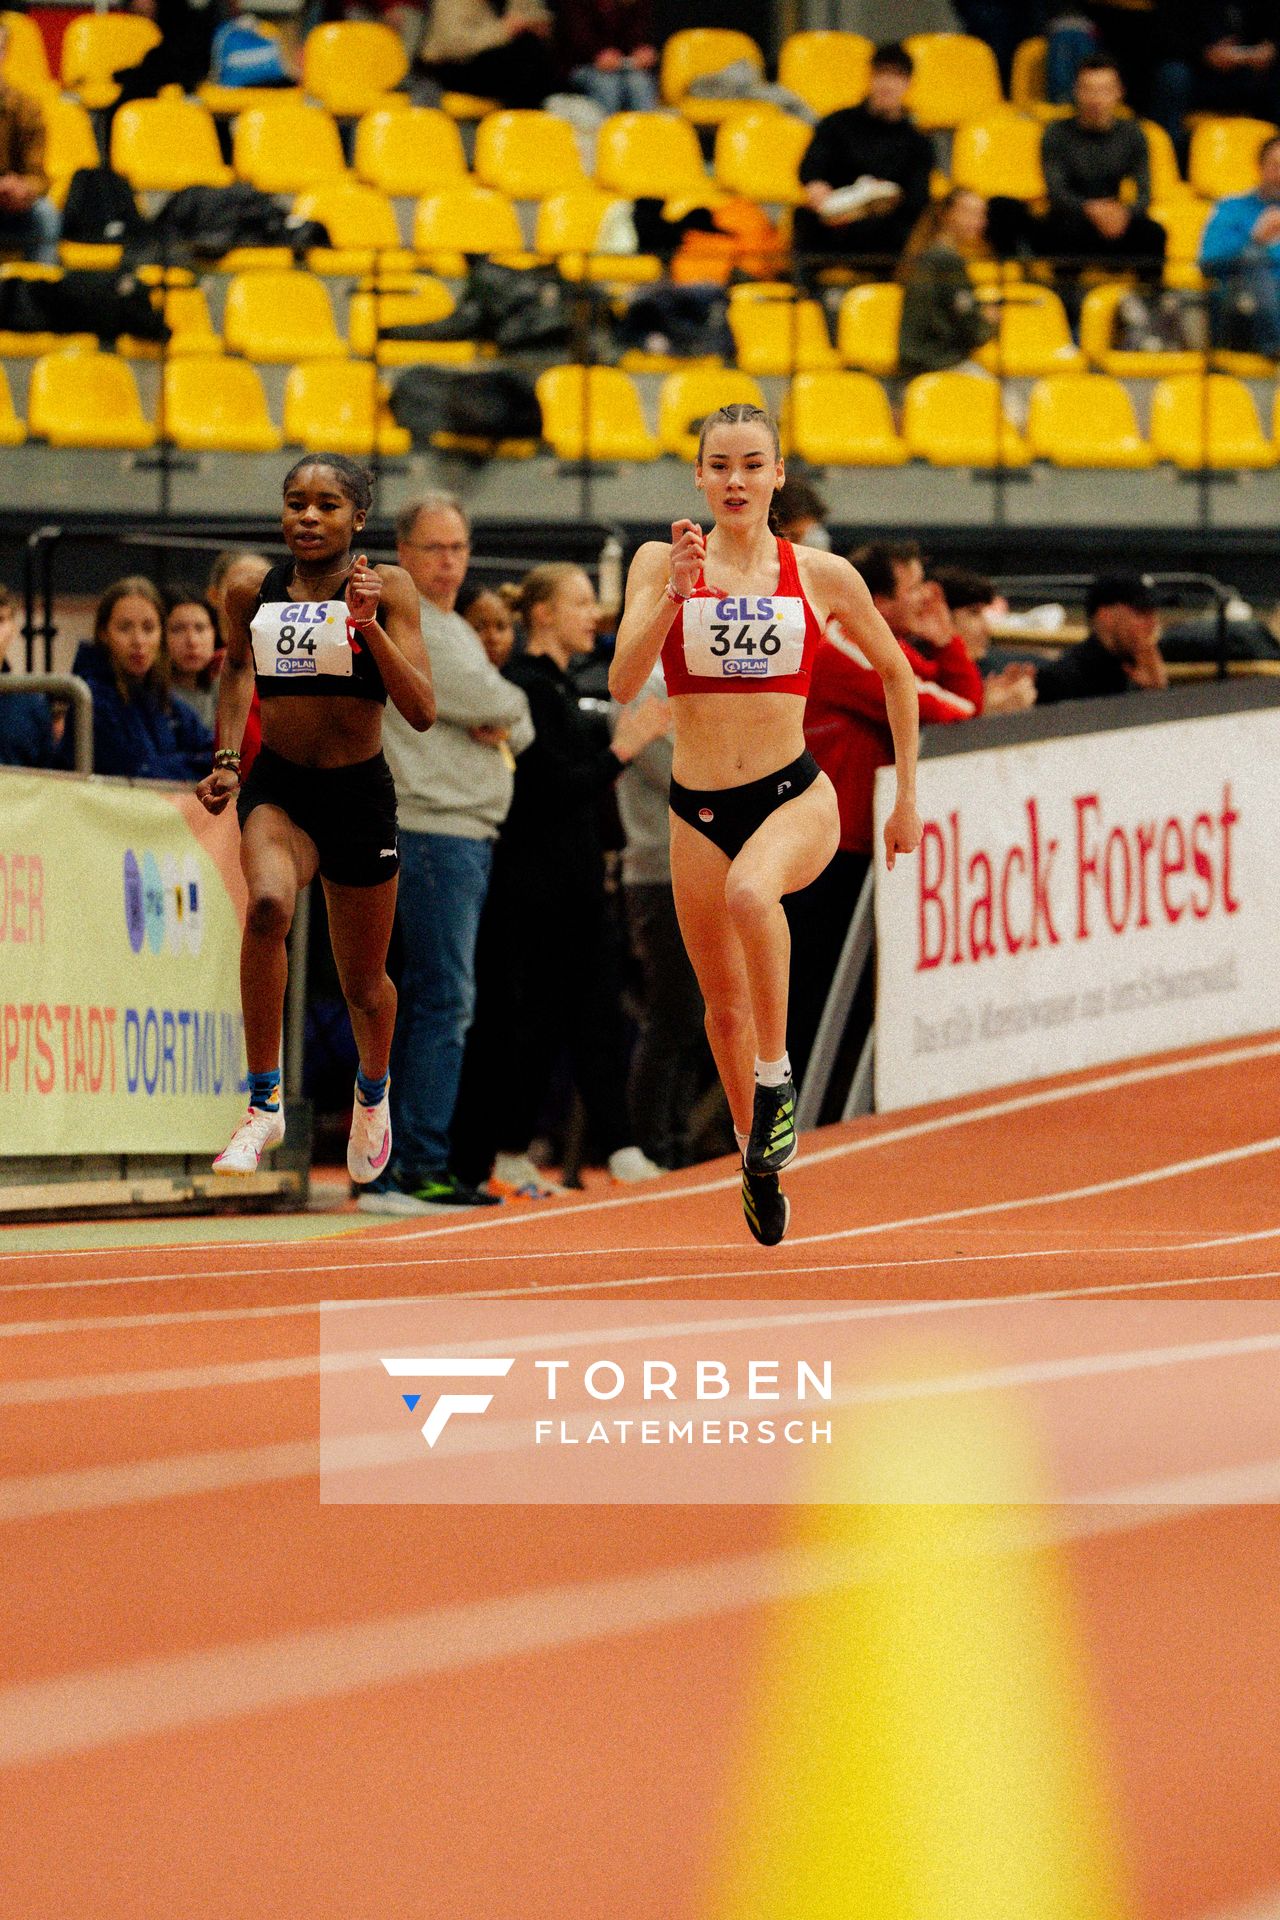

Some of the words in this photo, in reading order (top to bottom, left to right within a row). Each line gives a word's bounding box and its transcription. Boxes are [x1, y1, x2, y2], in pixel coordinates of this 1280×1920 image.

[276, 625, 317, 655] 84
[710, 624, 781, 656] 346
[292, 660, 315, 669] PLAN
[741, 661, 767, 669] PLAN
[915, 796, 1060, 973] Black
[1072, 781, 1241, 940] Forest
[0, 1002, 117, 1095] PTSTADT
